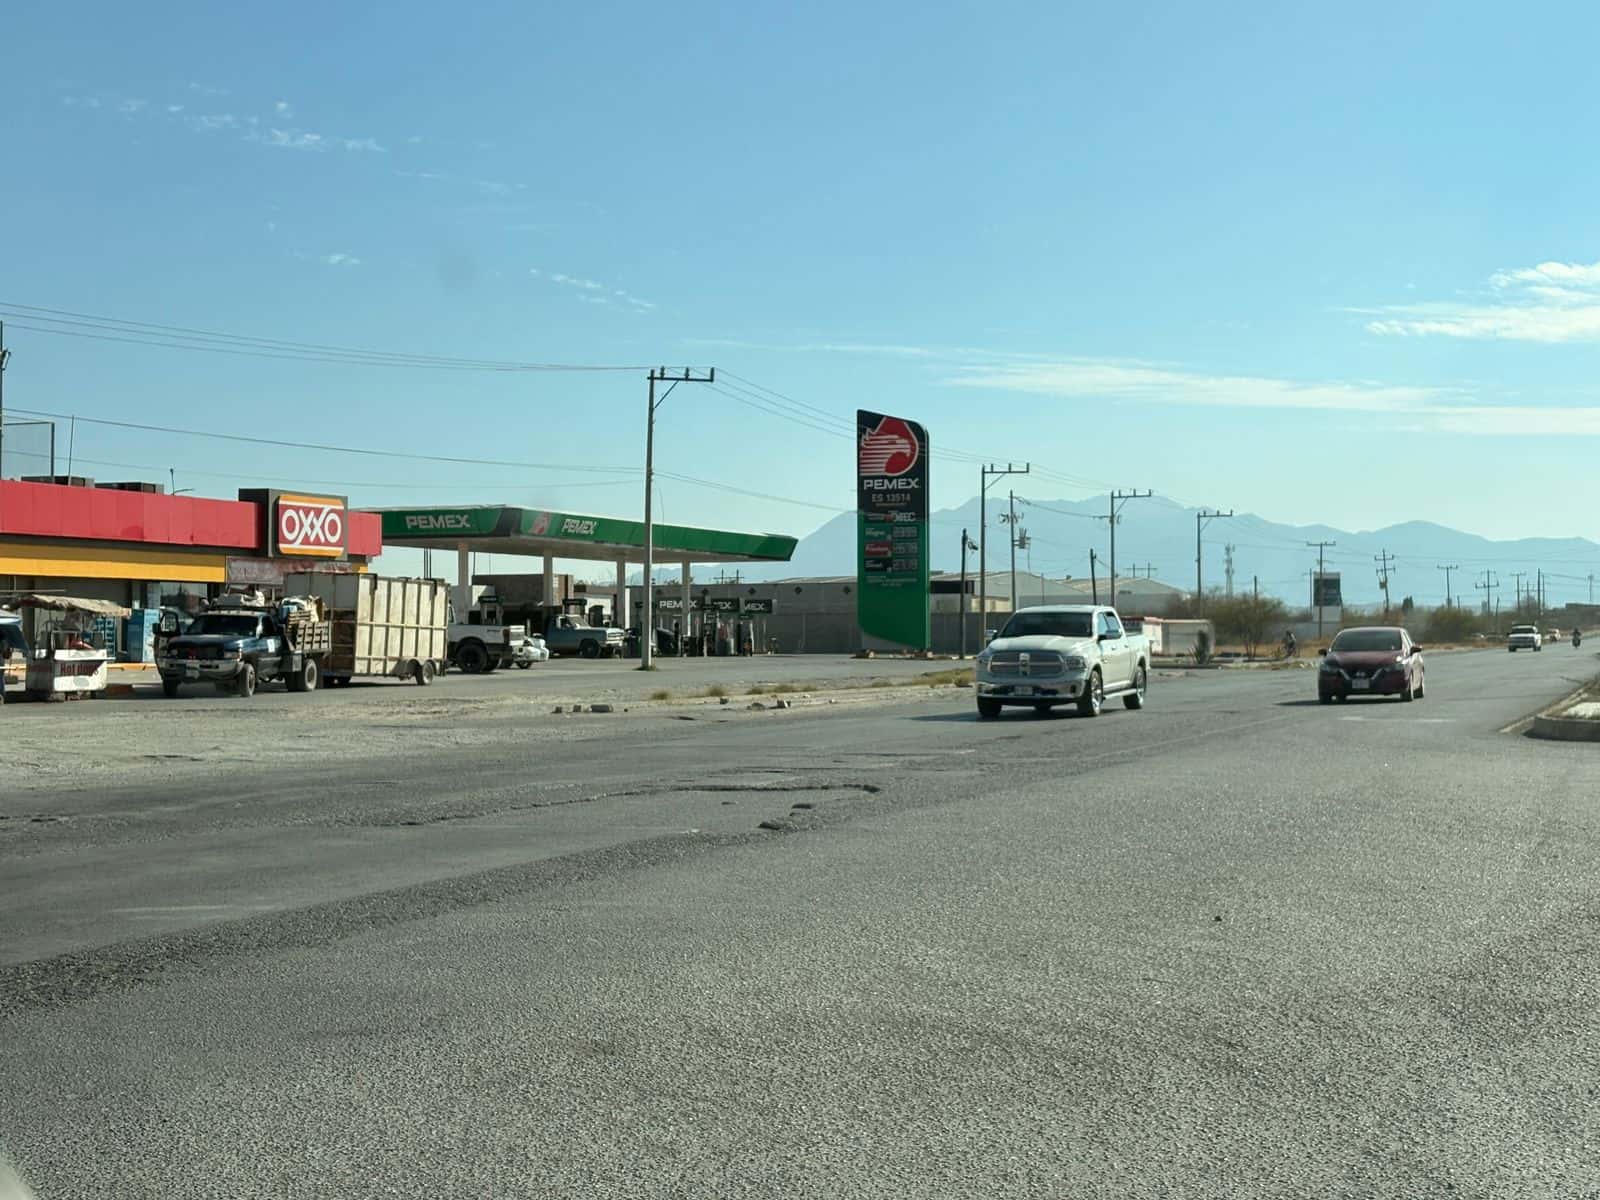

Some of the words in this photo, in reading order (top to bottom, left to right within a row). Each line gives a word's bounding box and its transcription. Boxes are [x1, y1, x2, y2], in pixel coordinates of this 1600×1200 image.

[863, 478, 920, 490] PEMEX
[281, 506, 342, 546] OXXO
[405, 514, 471, 529] PEMEX
[561, 518, 597, 535] PEMEX
[659, 600, 697, 609] PEMX
